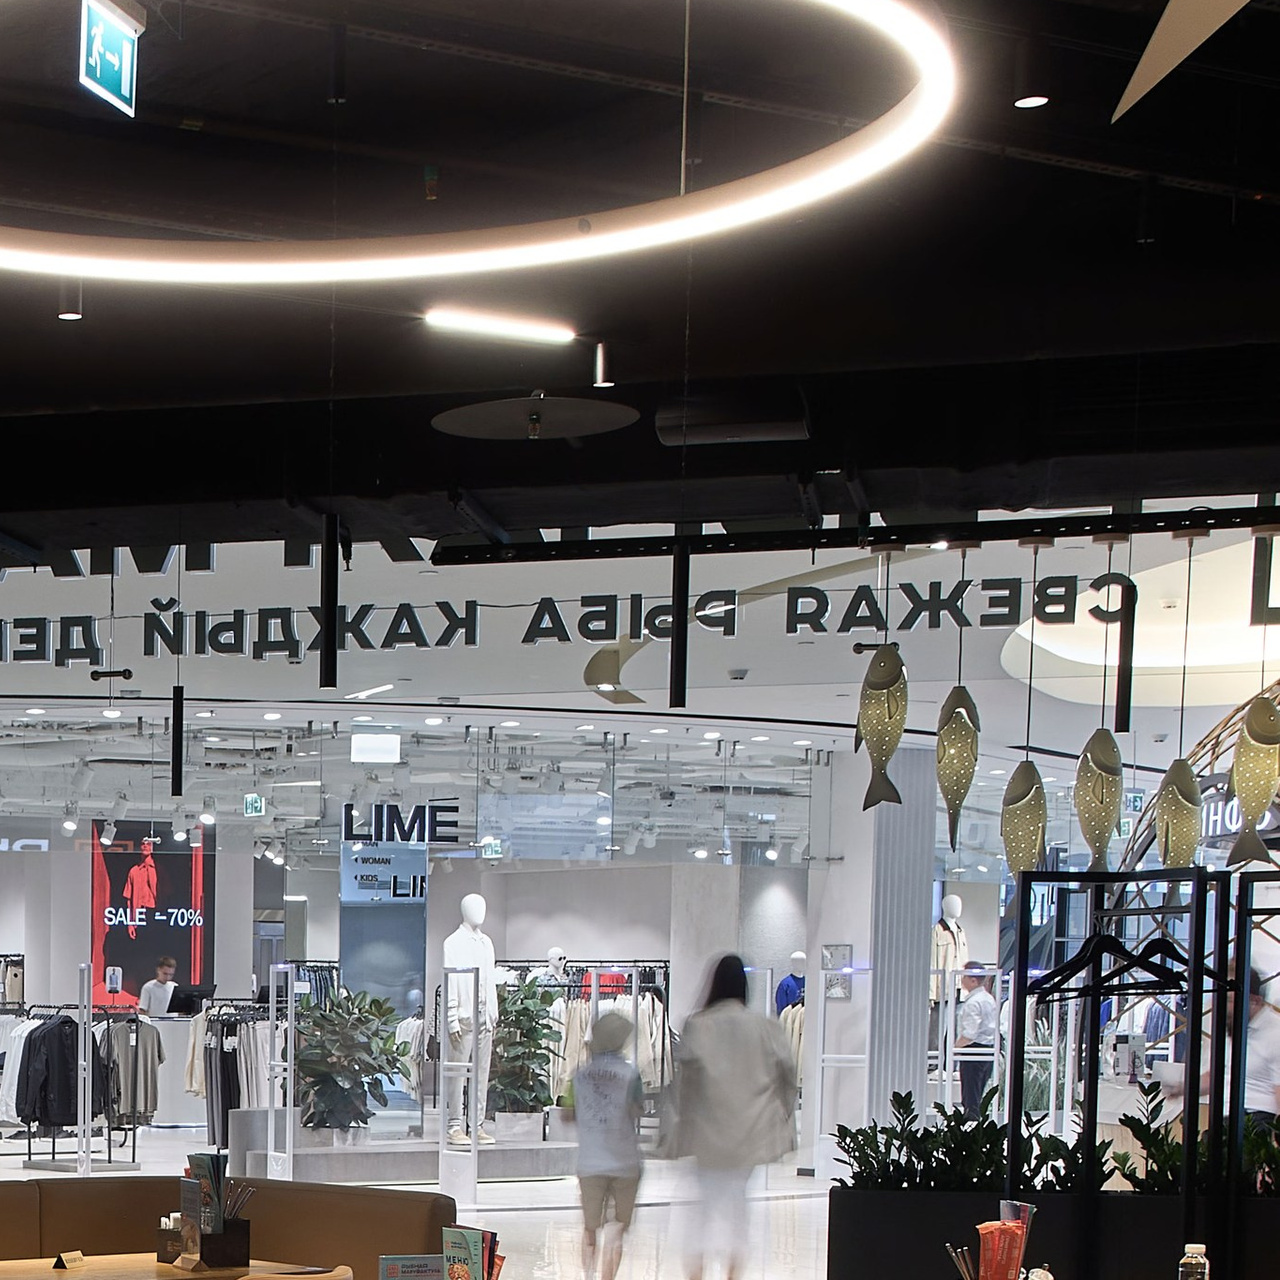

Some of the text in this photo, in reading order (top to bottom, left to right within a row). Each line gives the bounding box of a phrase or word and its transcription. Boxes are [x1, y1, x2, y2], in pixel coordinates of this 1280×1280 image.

[360, 857, 392, 865] WOMAN
[360, 874, 379, 882] KIDS
[103, 907, 147, 926] SALE
[446, 1254, 469, 1266] МЕНЮ
